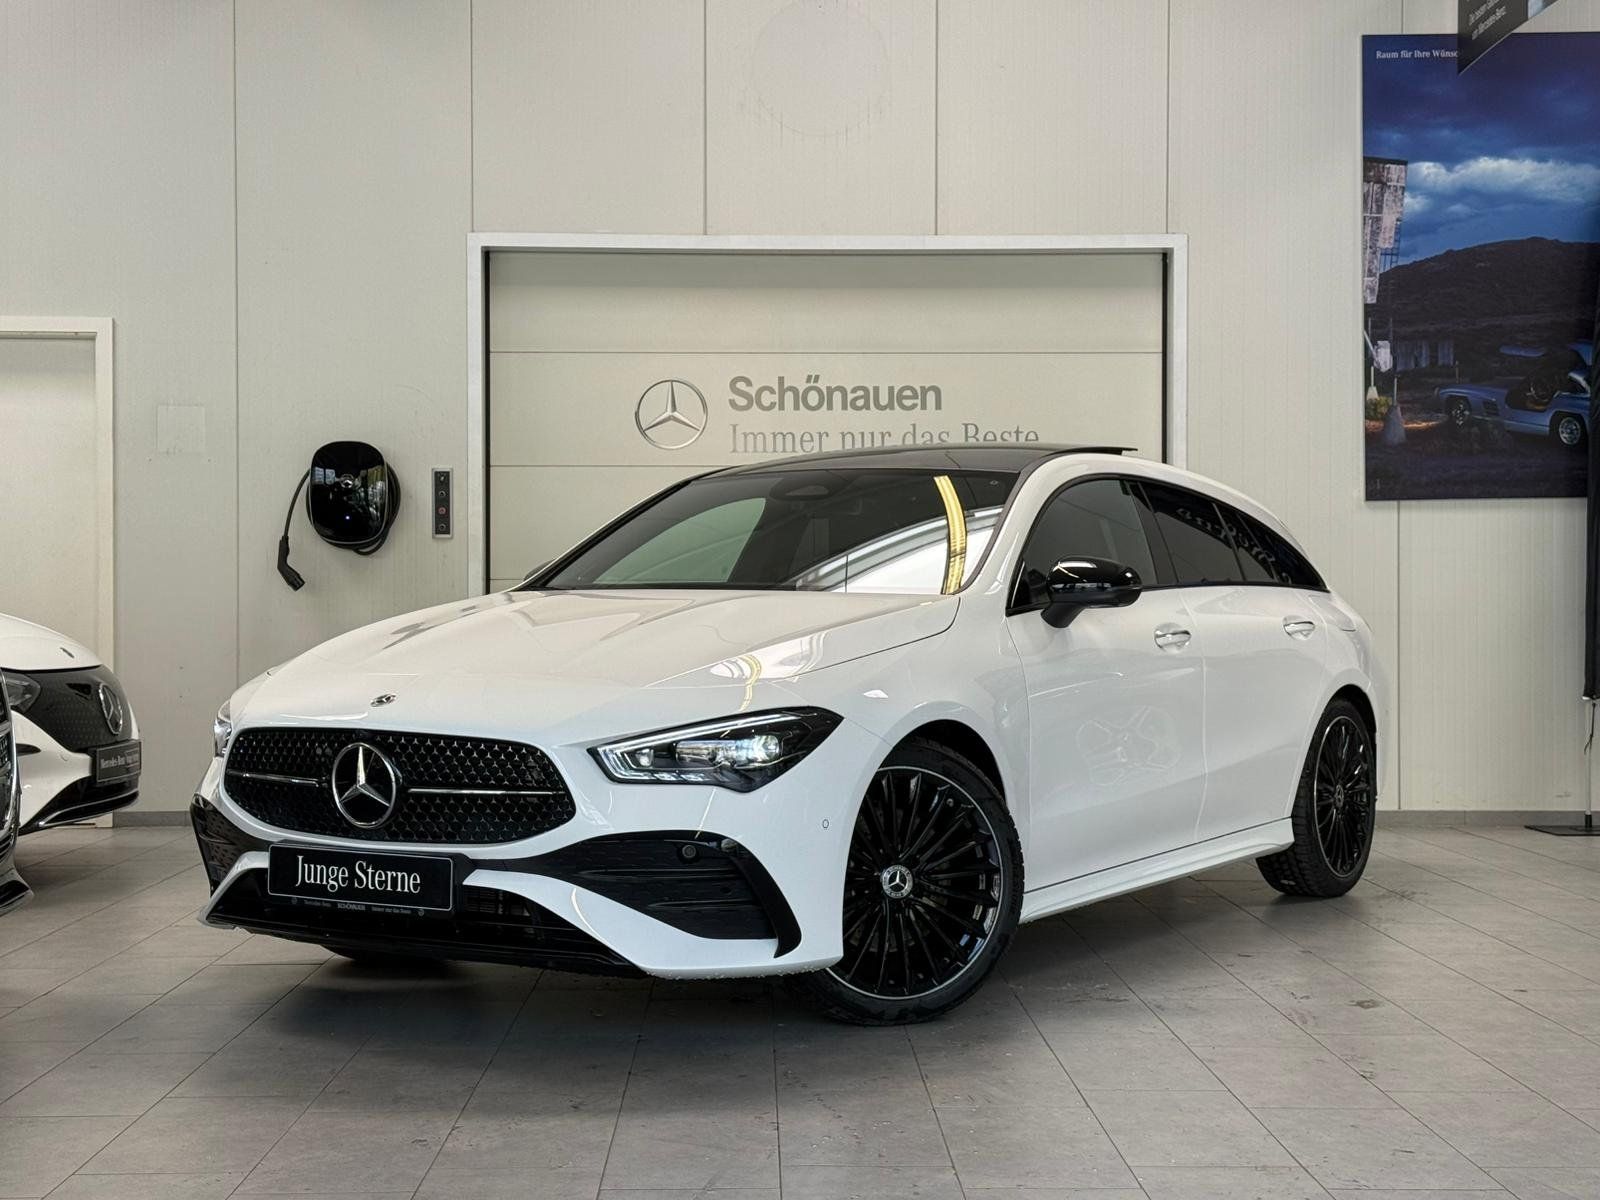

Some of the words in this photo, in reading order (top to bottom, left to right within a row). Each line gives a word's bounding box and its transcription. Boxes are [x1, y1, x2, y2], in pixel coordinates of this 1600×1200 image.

[1376, 50, 1399, 59] Raum
[1400, 49, 1413, 58] für
[1414, 49, 1431, 58] Ihre
[728, 374, 943, 413] Schönauen
[729, 423, 829, 454] Immer
[840, 431, 892, 451] nur
[902, 423, 950, 446] das
[296, 855, 349, 893] Junge
[354, 860, 421, 894] Sterne
